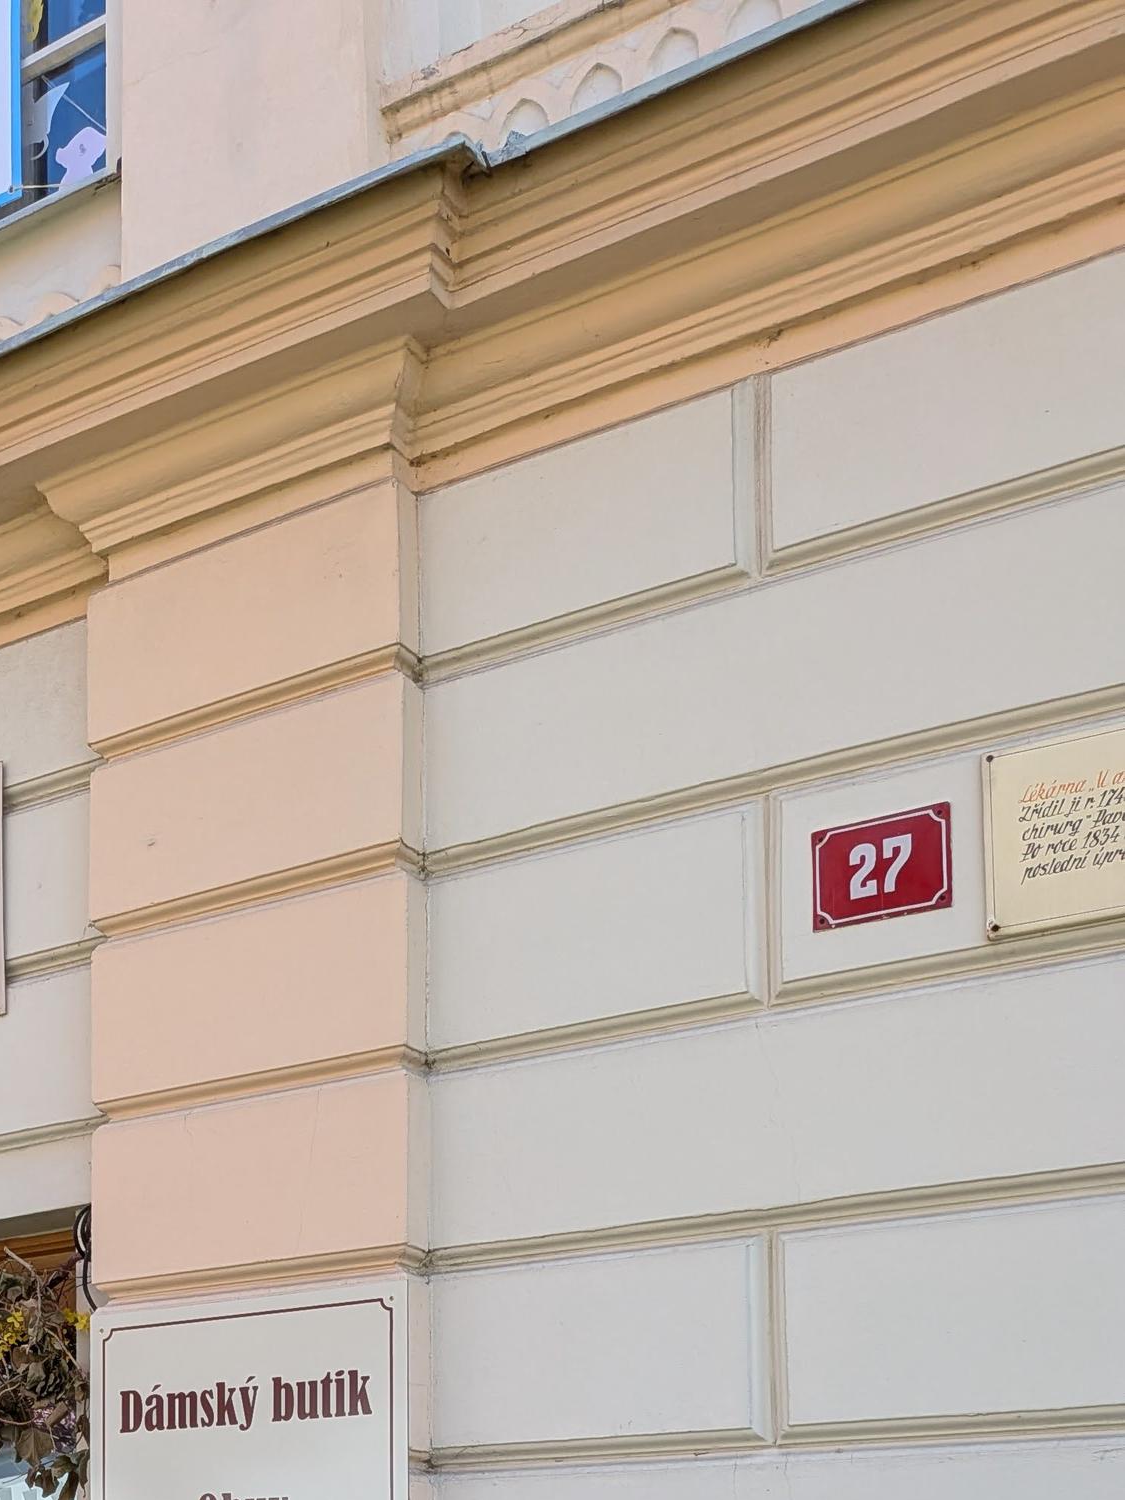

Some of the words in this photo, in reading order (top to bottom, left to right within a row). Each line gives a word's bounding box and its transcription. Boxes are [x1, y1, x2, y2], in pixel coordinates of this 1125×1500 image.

[1018, 780, 1087, 803] Lékárna
[1018, 798, 1065, 822] Zřídil
[1064, 796, 1081, 818] ji
[1097, 786, 1125, 808] 174
[1019, 842, 1045, 863] Po
[1044, 838, 1078, 857] roce
[1081, 825, 1121, 849] 1834
[1022, 819, 1083, 841] chirurg
[849, 834, 913, 901] 27
[1020, 850, 1091, 886] poslední
[119, 1375, 259, 1434] Dámský
[271, 1369, 373, 1423] butik
